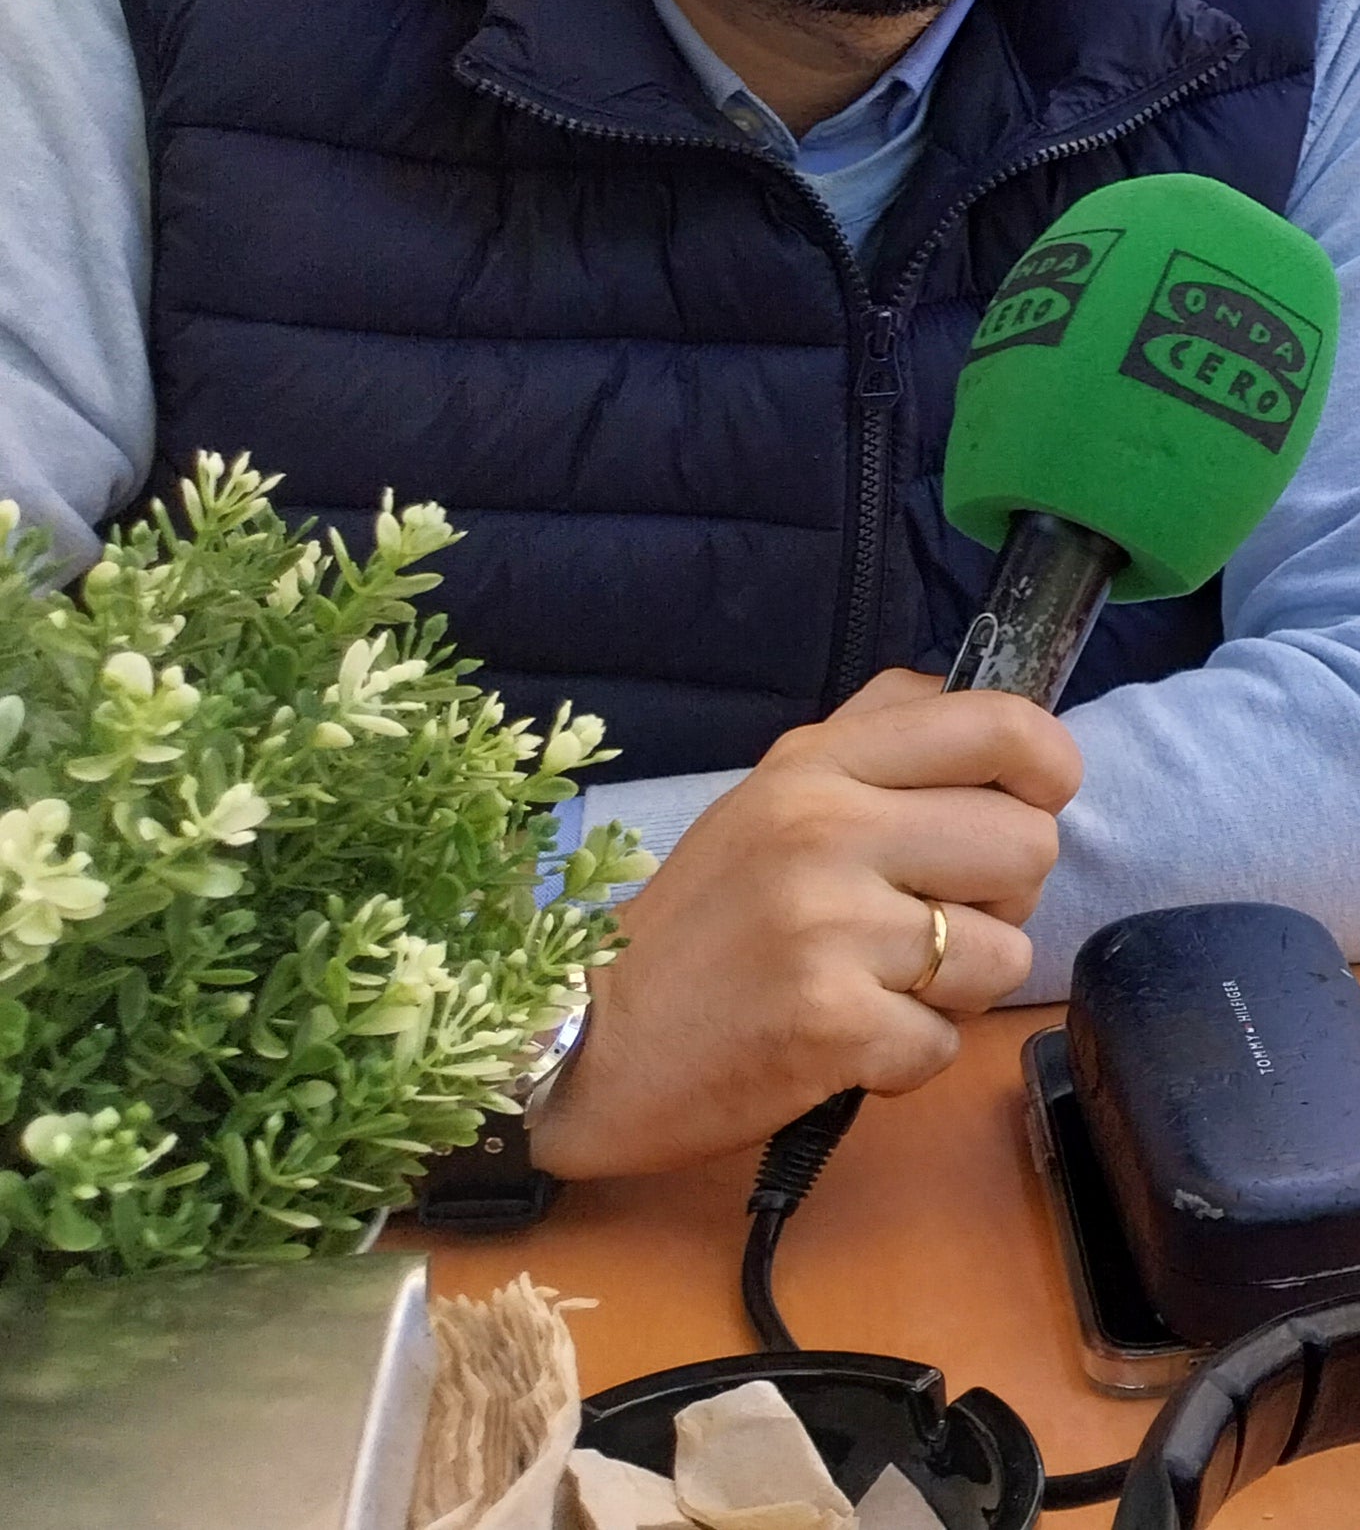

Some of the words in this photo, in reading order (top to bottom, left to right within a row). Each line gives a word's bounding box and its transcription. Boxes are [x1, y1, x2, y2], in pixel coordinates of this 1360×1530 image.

[1184, 287, 1296, 367] ONDA
[1168, 338, 1283, 416] CERO
[1221, 980, 1253, 1022] HILFIGER
[1245, 1034, 1275, 1075] TOMMY
